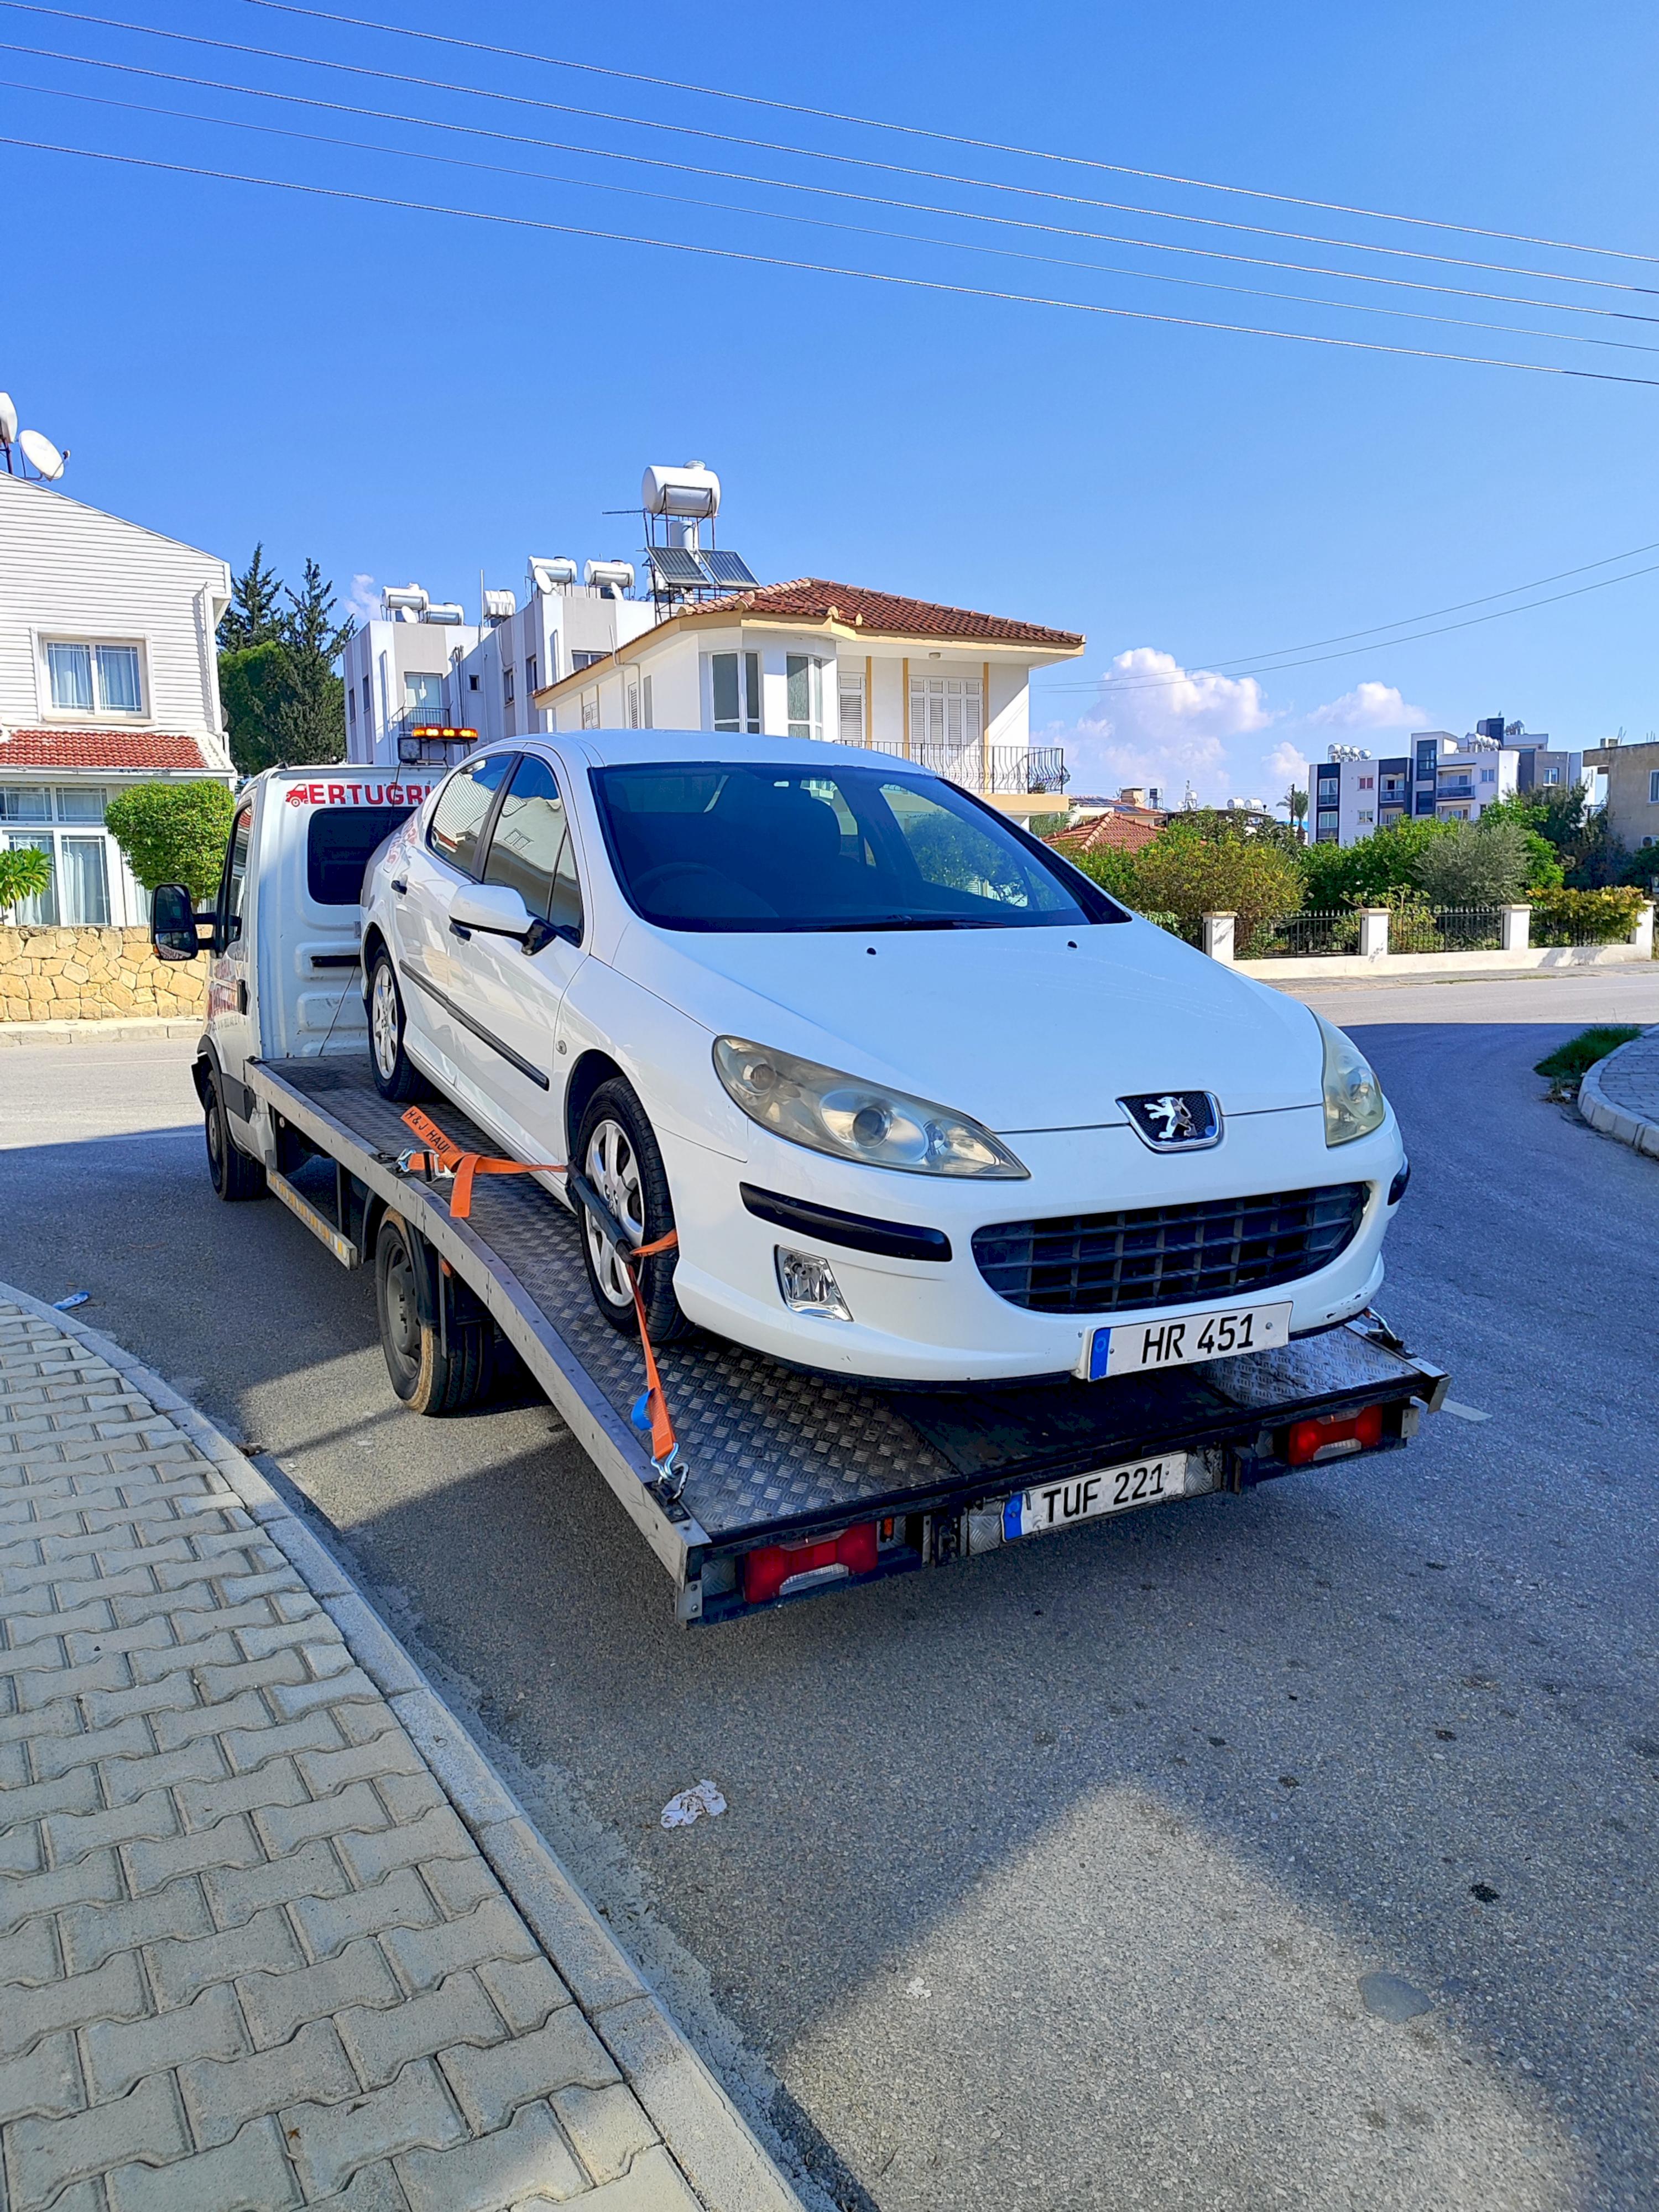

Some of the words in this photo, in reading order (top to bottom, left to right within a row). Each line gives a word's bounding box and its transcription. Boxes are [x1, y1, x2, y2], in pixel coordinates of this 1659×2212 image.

[405, 1110, 416, 1119] H
[412, 1115, 422, 1126] &
[1142, 1323, 1186, 1364] HR
[1197, 1313, 1254, 1354] 451
[1043, 1478, 1102, 1523] TUF
[1113, 1463, 1164, 1505] 221
